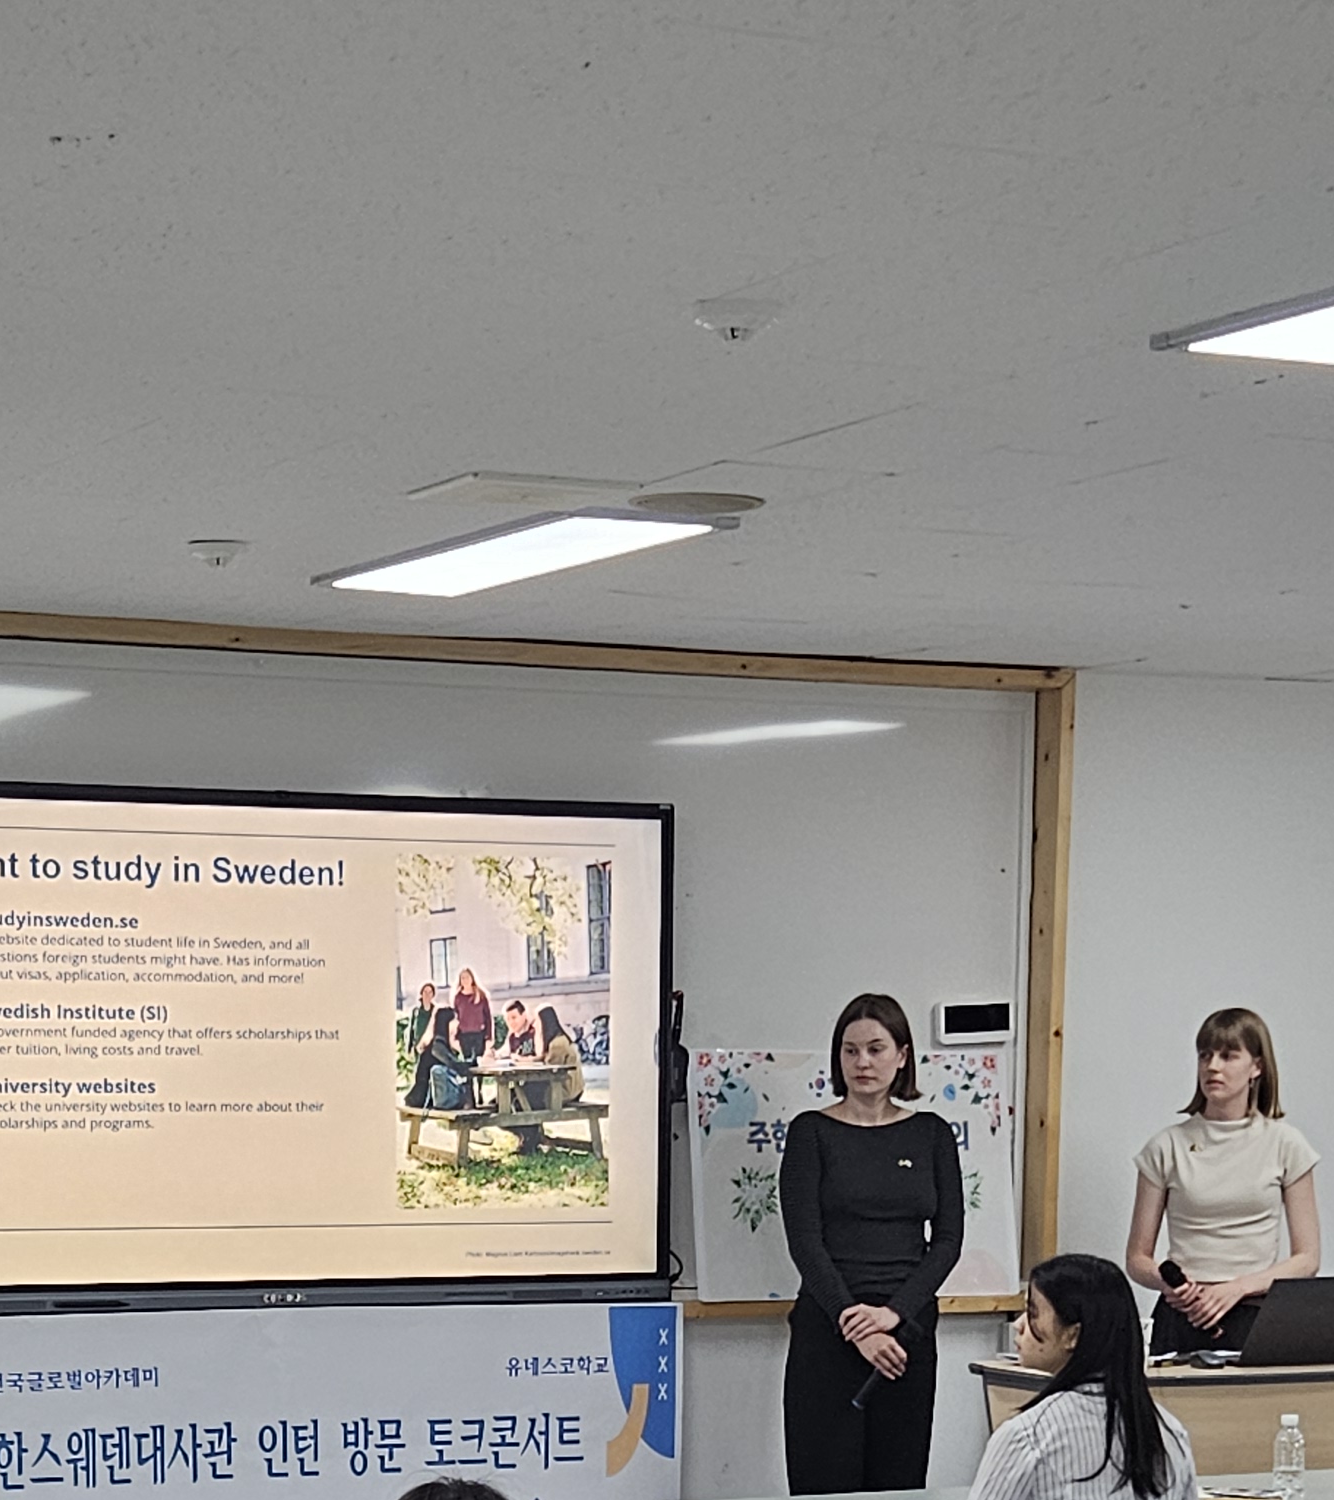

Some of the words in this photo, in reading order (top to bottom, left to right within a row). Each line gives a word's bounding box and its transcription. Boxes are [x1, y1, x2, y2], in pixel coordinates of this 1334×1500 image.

[30, 853, 61, 879] to
[72, 854, 162, 888] study
[174, 856, 200, 883] in
[212, 857, 344, 886] Sweden!
[41, 934, 104, 947] dedicated
[108, 937, 121, 947] to
[124, 936, 172, 948] student
[177, 937, 195, 949] life
[199, 938, 210, 949] in
[214, 938, 266, 951] Sweden,
[269, 939, 292, 950] and
[296, 939, 310, 950] all
[42, 952, 87, 967] foreign
[91, 953, 146, 965] students
[151, 954, 186, 968] might
[190, 954, 223, 966] have.
[226, 955, 250, 967] Has
[253, 956, 325, 968] information
[16, 968, 52, 982] visas,
[55, 968, 129, 983] application,
[133, 972, 237, 984] accommodation,
[241, 972, 264, 984] and
[268, 973, 304, 984] more!
[57, 1004, 135, 1020] Institute
[140, 1005, 168, 1023] (SI)
[71, 1026, 117, 1038] funded
[119, 1029, 164, 1042] agency
[168, 1027, 192, 1039] that
[196, 1027, 232, 1039] offers
[236, 1028, 312, 1043] scholarships
[315, 1029, 339, 1040] that
[15, 1044, 61, 1056] tuition,
[65, 1044, 98, 1058] living
[102, 1045, 134, 1056] costs
[137, 1044, 161, 1056] and
[165, 1044, 203, 1056] travel.
[76, 1078, 156, 1094] websites
[20, 1101, 41, 1112] the
[45, 1101, 107, 1115] university
[110, 1101, 164, 1112] websites
[169, 1102, 181, 1112] to
[185, 1101, 217, 1112] learn
[220, 1103, 253, 1112] more
[257, 1101, 292, 1112] about
[296, 1101, 324, 1112] their
[61, 1118, 85, 1129] and
[90, 1119, 154, 1132] programs.
[506, 1356, 609, 1377] 유네스코학교
[258, 1418, 320, 1478] 인턴
[341, 1417, 406, 1476] 방문
[424, 1412, 584, 1470] 토크콘서트
